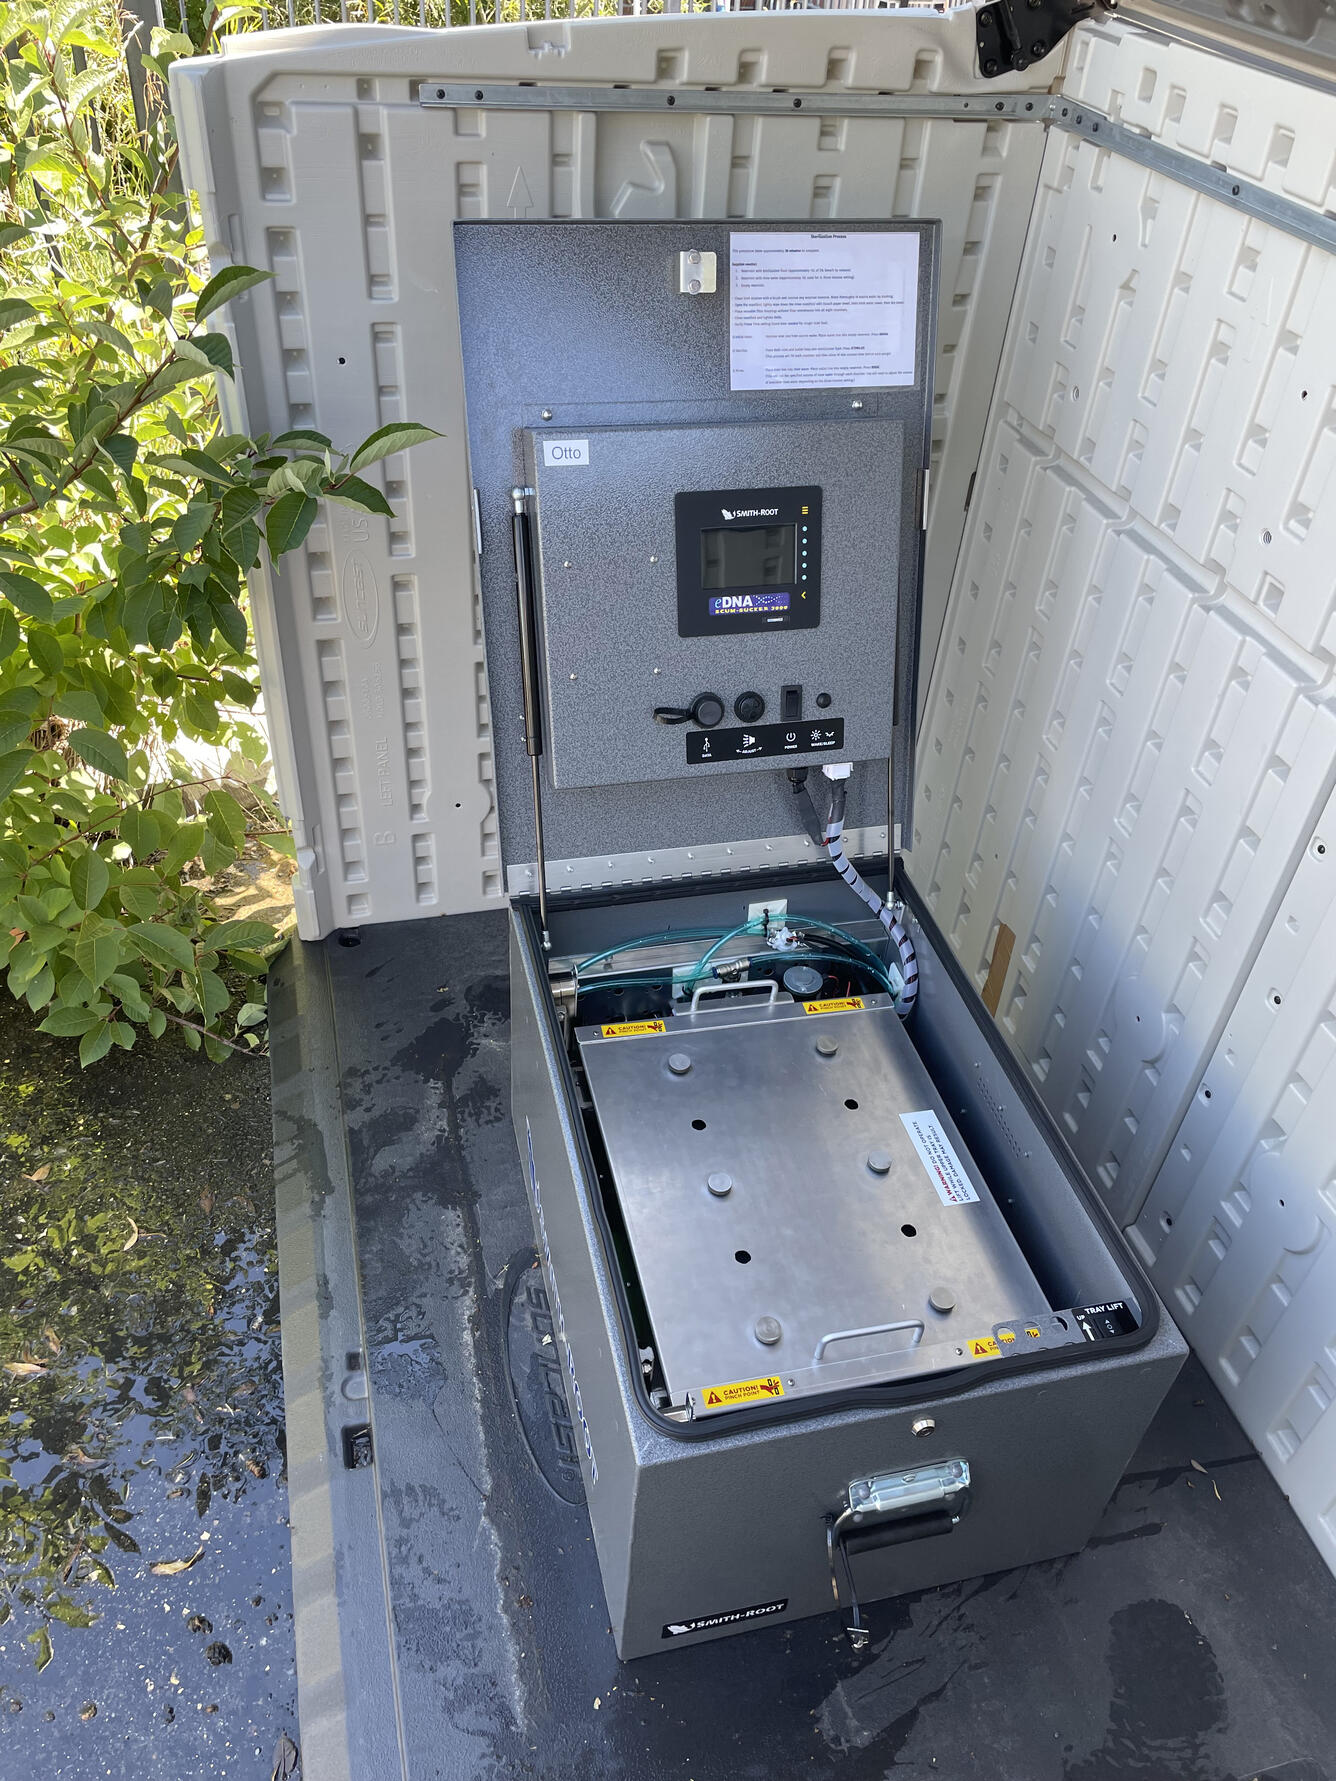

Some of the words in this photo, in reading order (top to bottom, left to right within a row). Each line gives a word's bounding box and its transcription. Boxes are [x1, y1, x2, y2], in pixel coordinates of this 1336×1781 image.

[552, 446, 581, 460] Otto
[736, 508, 778, 518] SMITH-ROOT
[714, 595, 753, 608] eDNA
[912, 1121, 926, 1143] OPERATE
[924, 1144, 932, 1155] NOT
[930, 1141, 939, 1154] TRAY
[938, 1144, 947, 1154] MAY
[944, 1155, 958, 1177] DAMAGE
[1084, 1305, 1105, 1314] TRAY
[723, 1385, 758, 1396] CAUTION!
[696, 1603, 785, 1628] SMITH-ROOT
